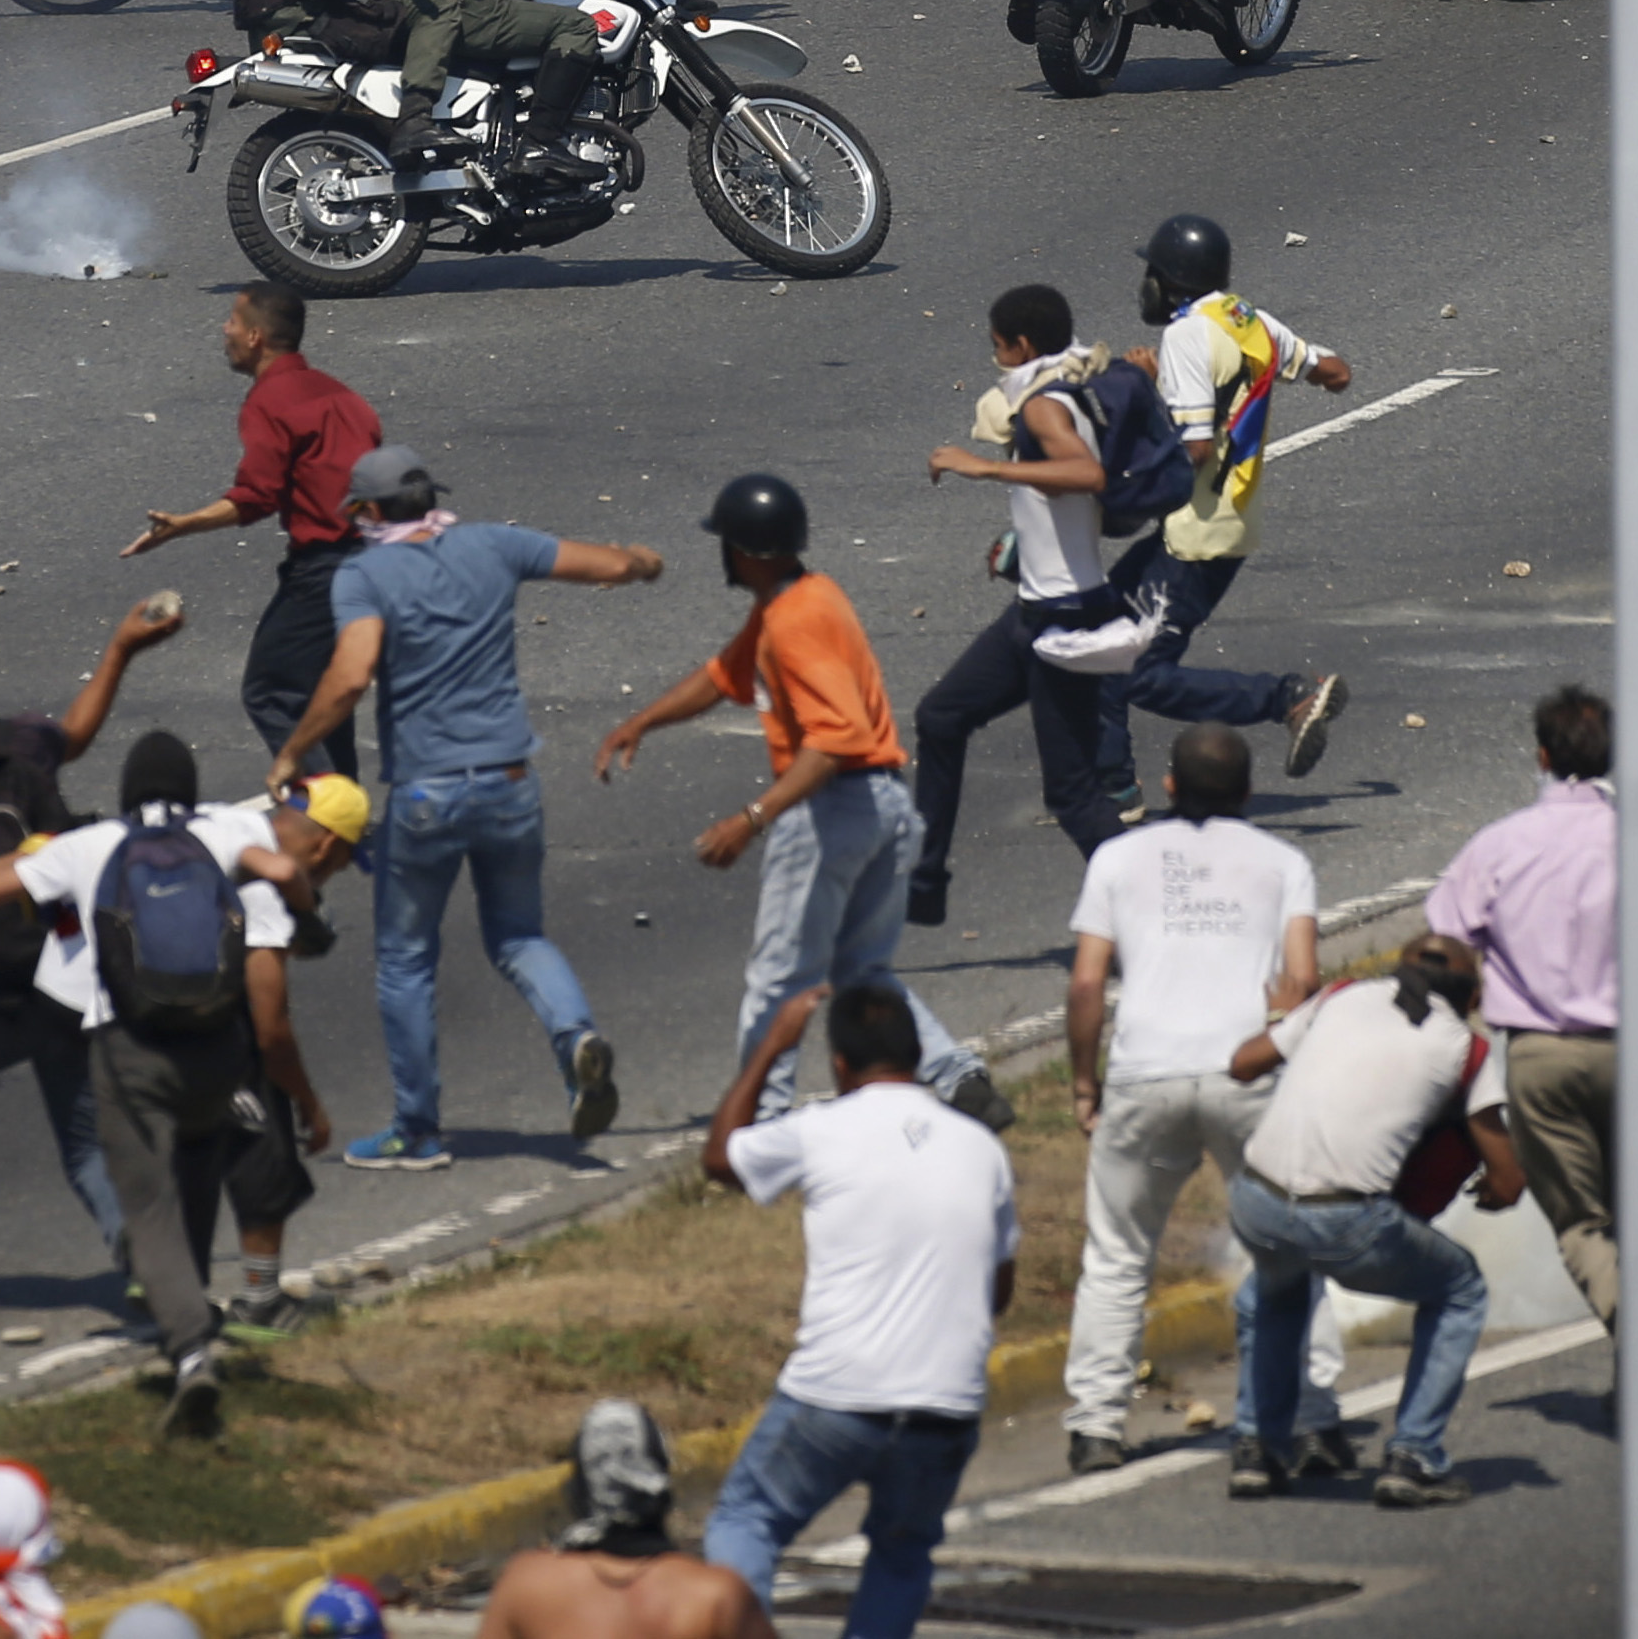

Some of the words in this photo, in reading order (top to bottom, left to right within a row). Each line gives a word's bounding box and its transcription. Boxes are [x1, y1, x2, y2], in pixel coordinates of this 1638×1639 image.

[1162, 849, 1185, 866] EL
[1162, 865, 1213, 883] QUE
[1163, 883, 1191, 900] SE
[1163, 899, 1243, 919] CANSA
[1163, 919, 1249, 937] PIERDE
